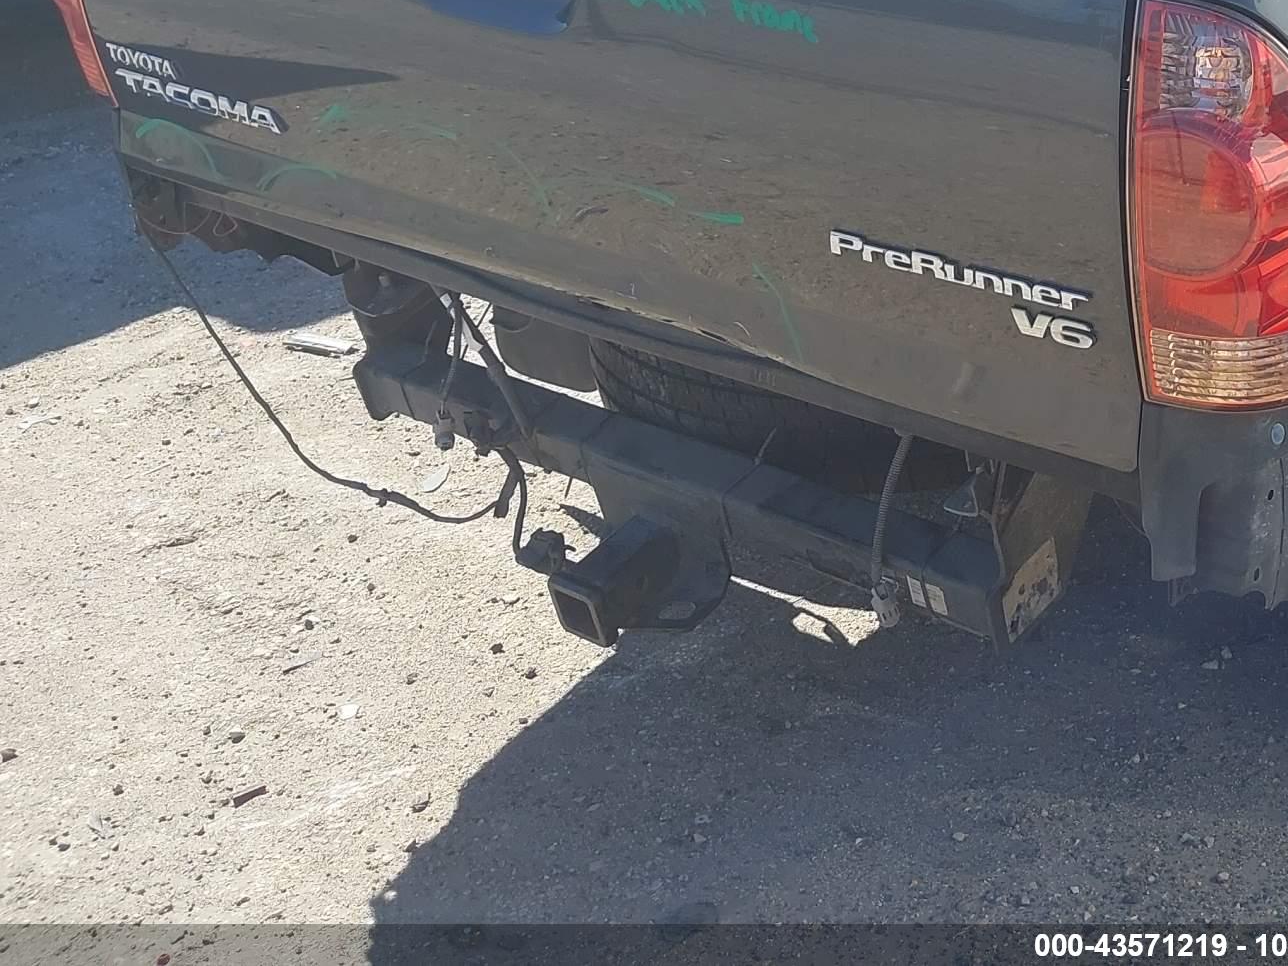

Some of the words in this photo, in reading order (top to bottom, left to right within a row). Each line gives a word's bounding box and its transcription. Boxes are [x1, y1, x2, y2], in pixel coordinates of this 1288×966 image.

[105, 42, 177, 80] TOYOTA
[115, 68, 281, 134] TACOMA
[829, 230, 1089, 311] PreRunner
[1010, 306, 1096, 349] V6
